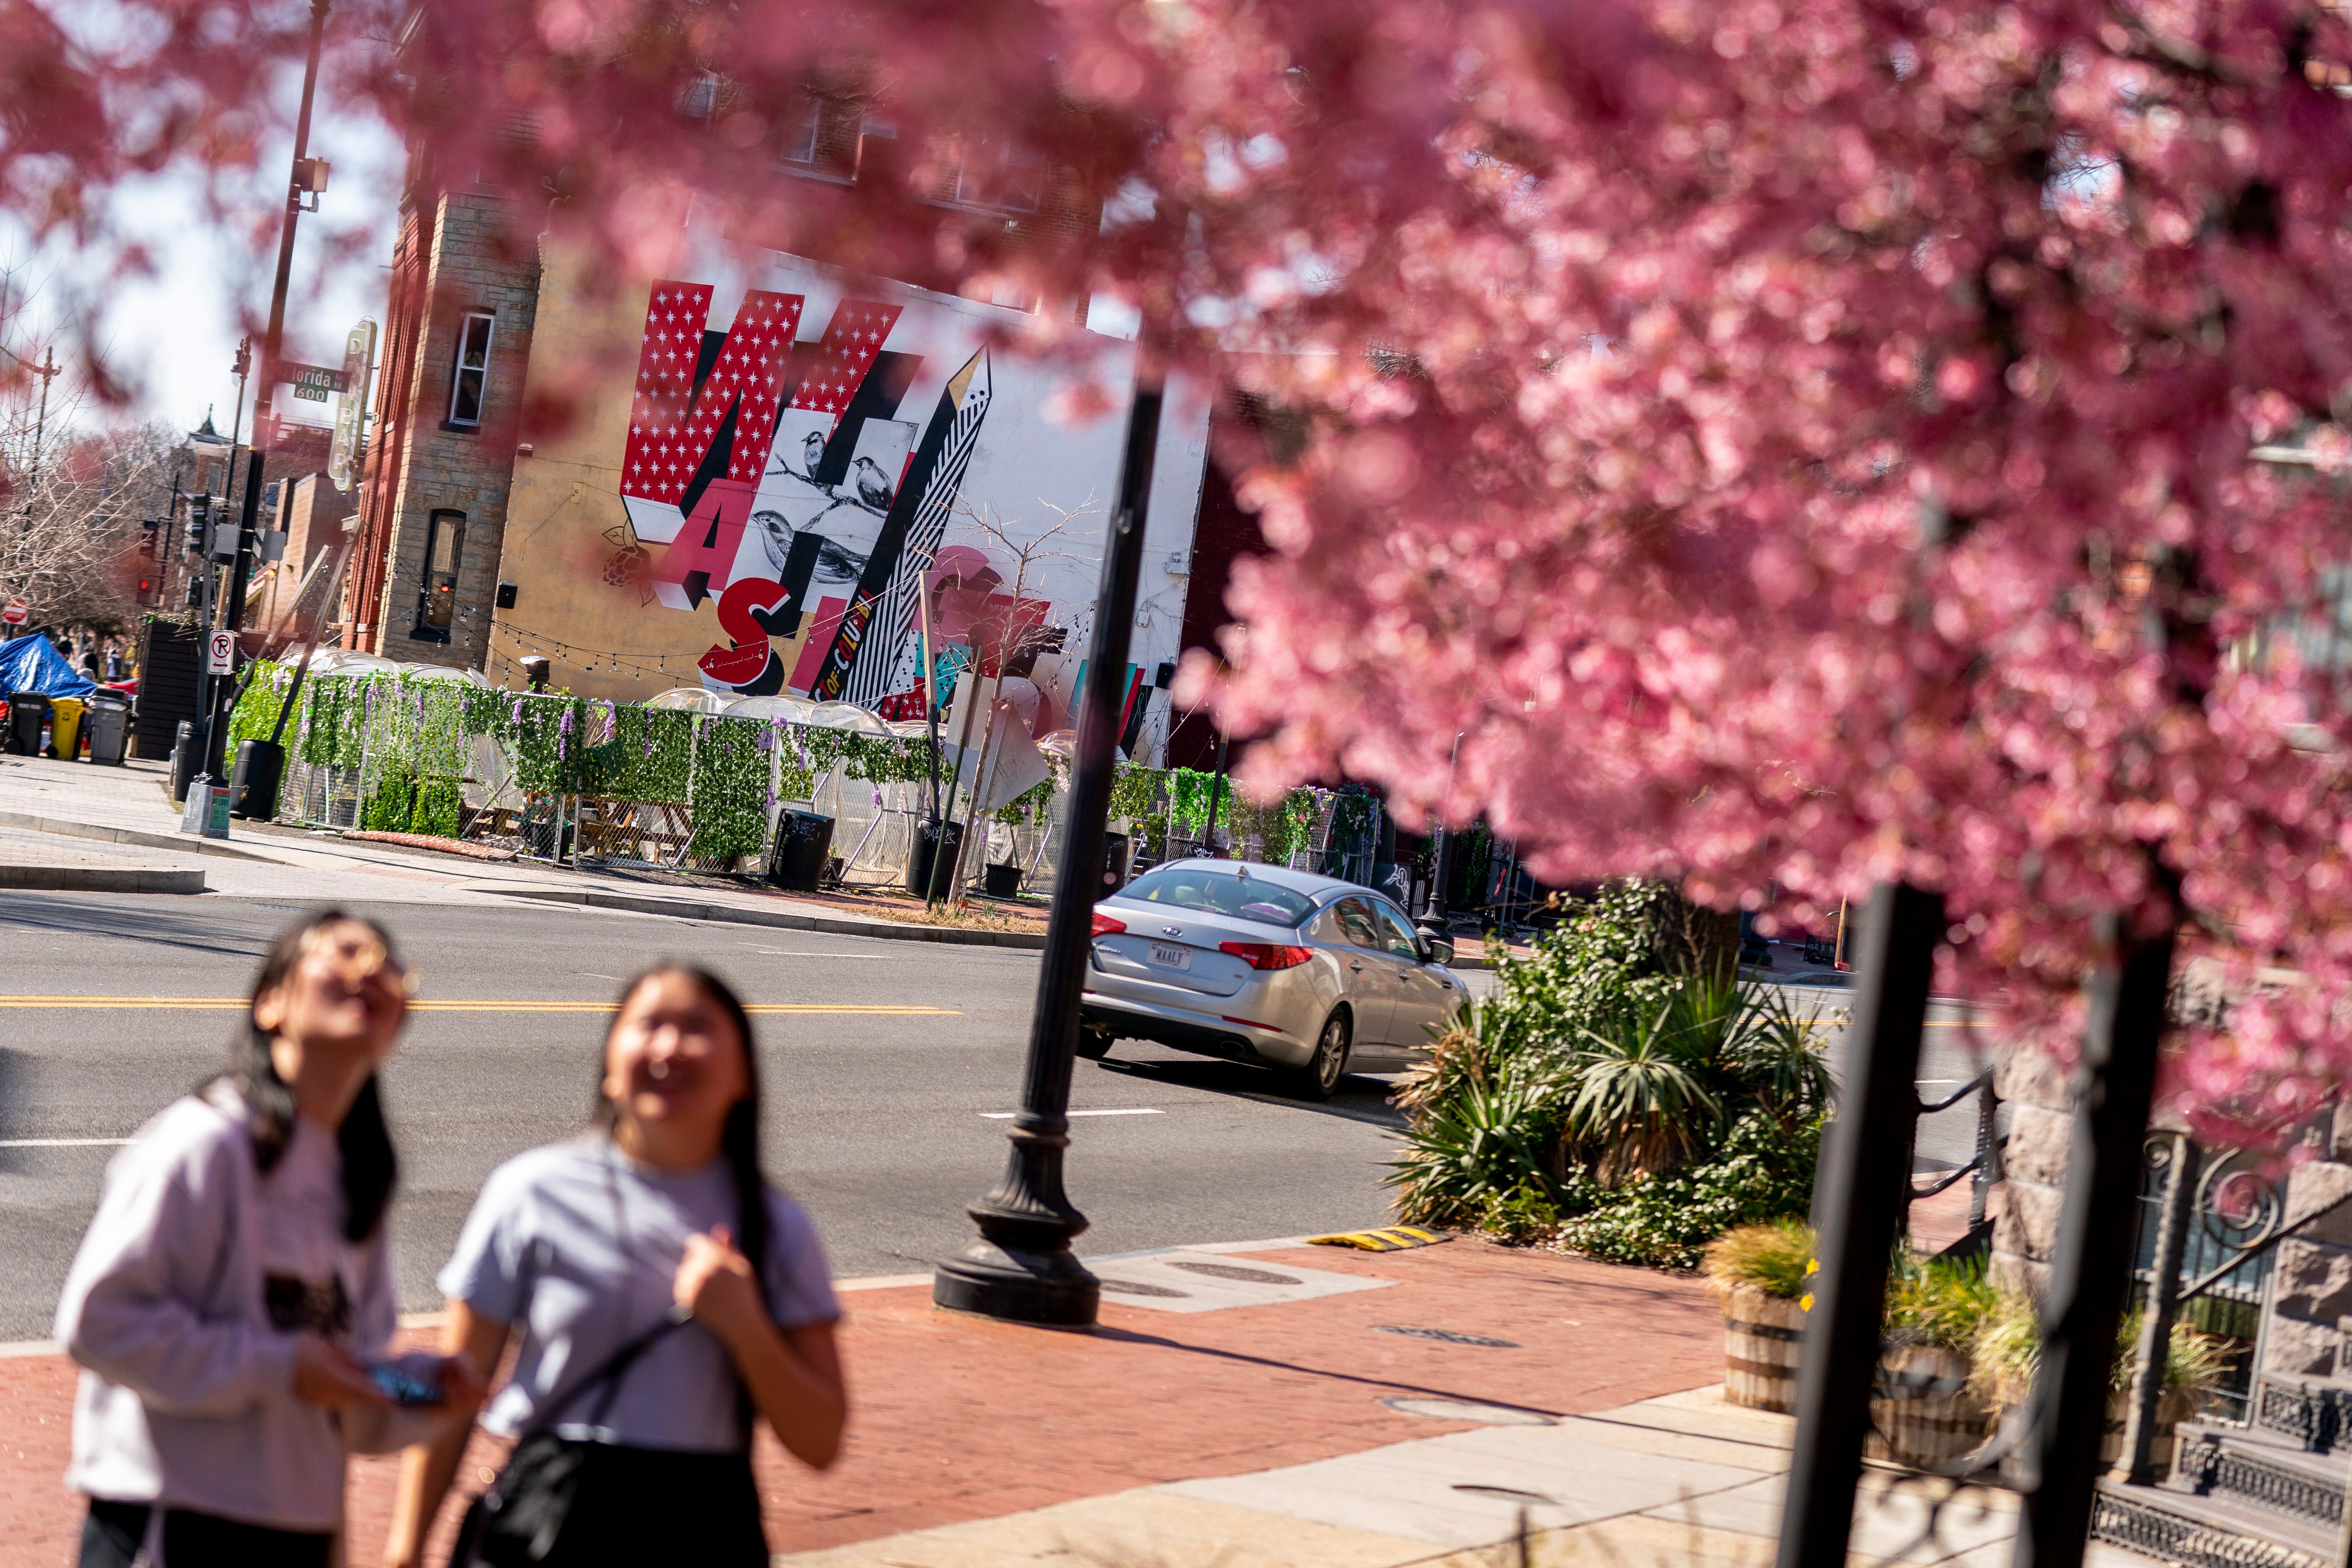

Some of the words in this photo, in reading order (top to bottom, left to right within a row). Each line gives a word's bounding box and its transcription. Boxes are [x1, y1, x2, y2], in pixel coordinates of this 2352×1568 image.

[284, 365, 330, 387] lorida
[334, 381, 342, 390] NW
[296, 388, 325, 402] 600
[834, 588, 875, 670] COLUMBIA
